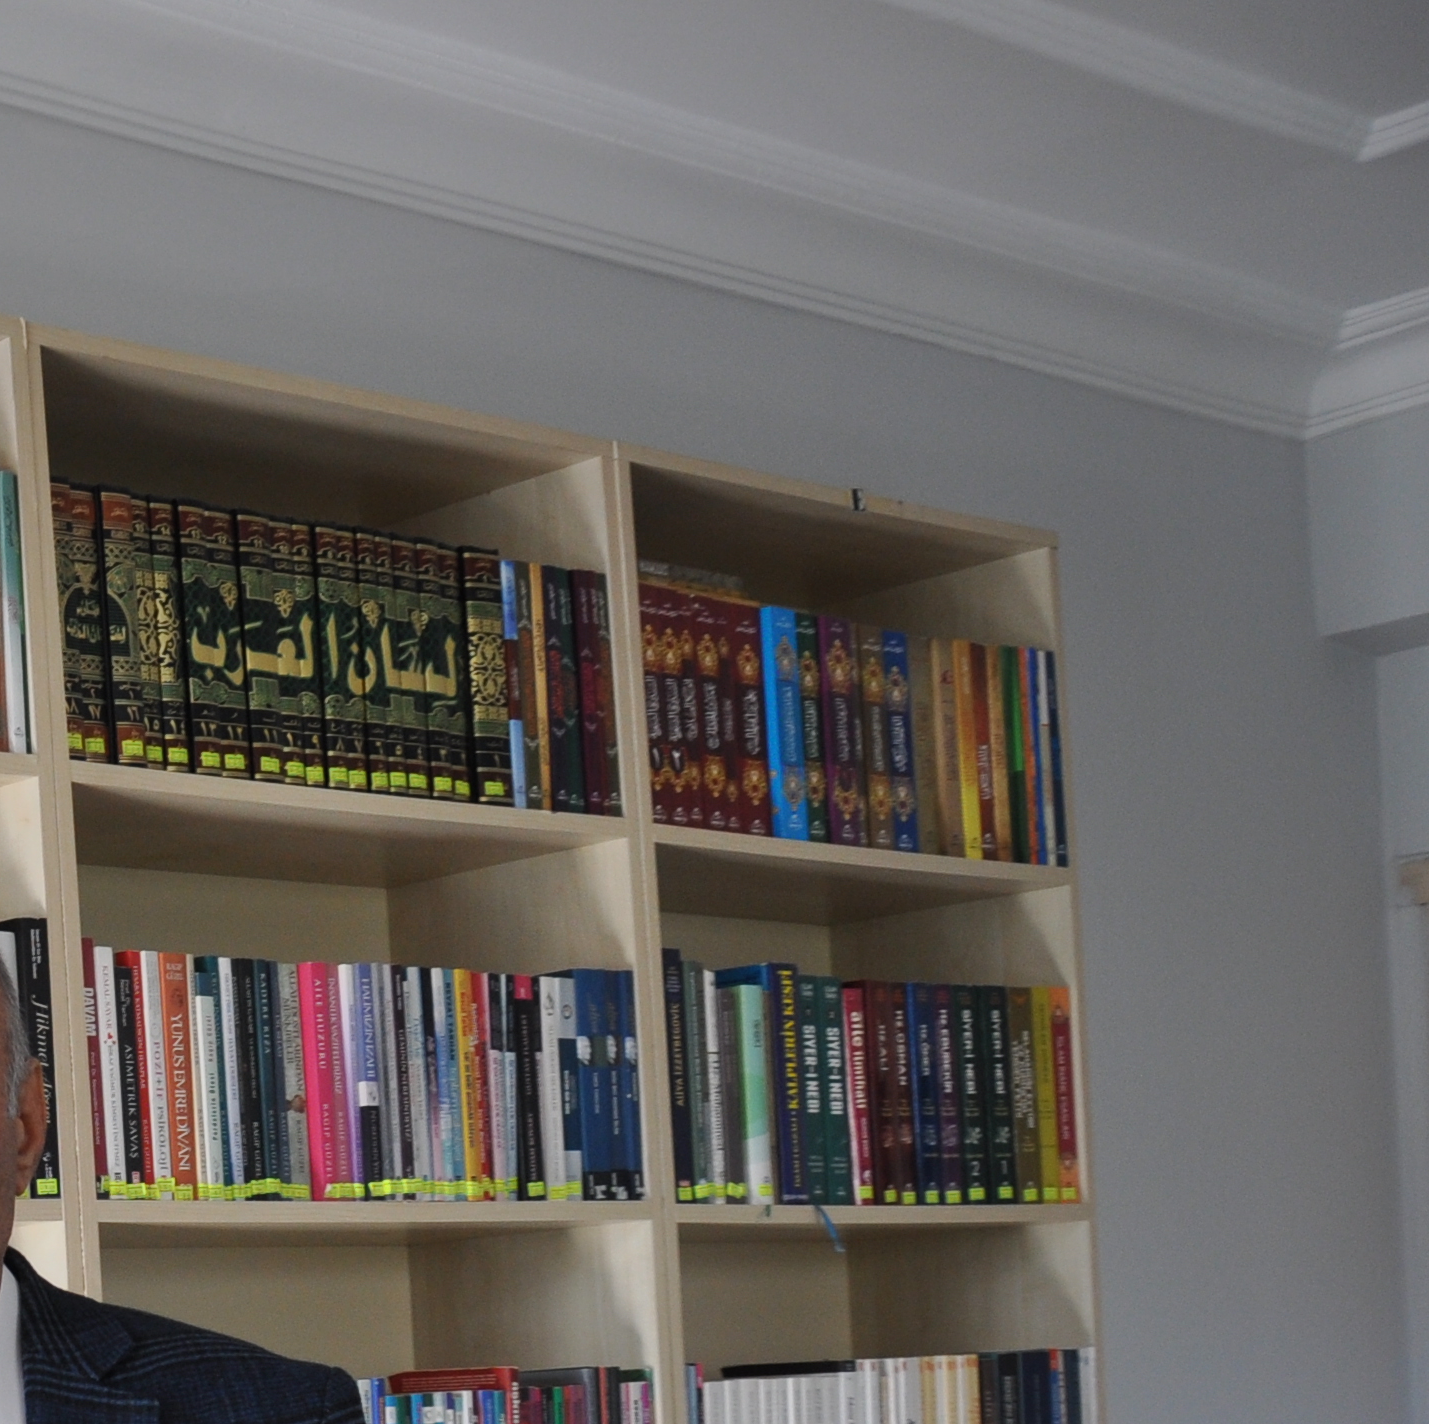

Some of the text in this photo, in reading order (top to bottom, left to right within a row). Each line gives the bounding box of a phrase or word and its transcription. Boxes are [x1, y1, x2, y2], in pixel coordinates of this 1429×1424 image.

[170, 1013, 185, 1071] YUNUS
[173, 1072, 188, 1117] EMRE
[970, 1160, 980, 1177] 2
